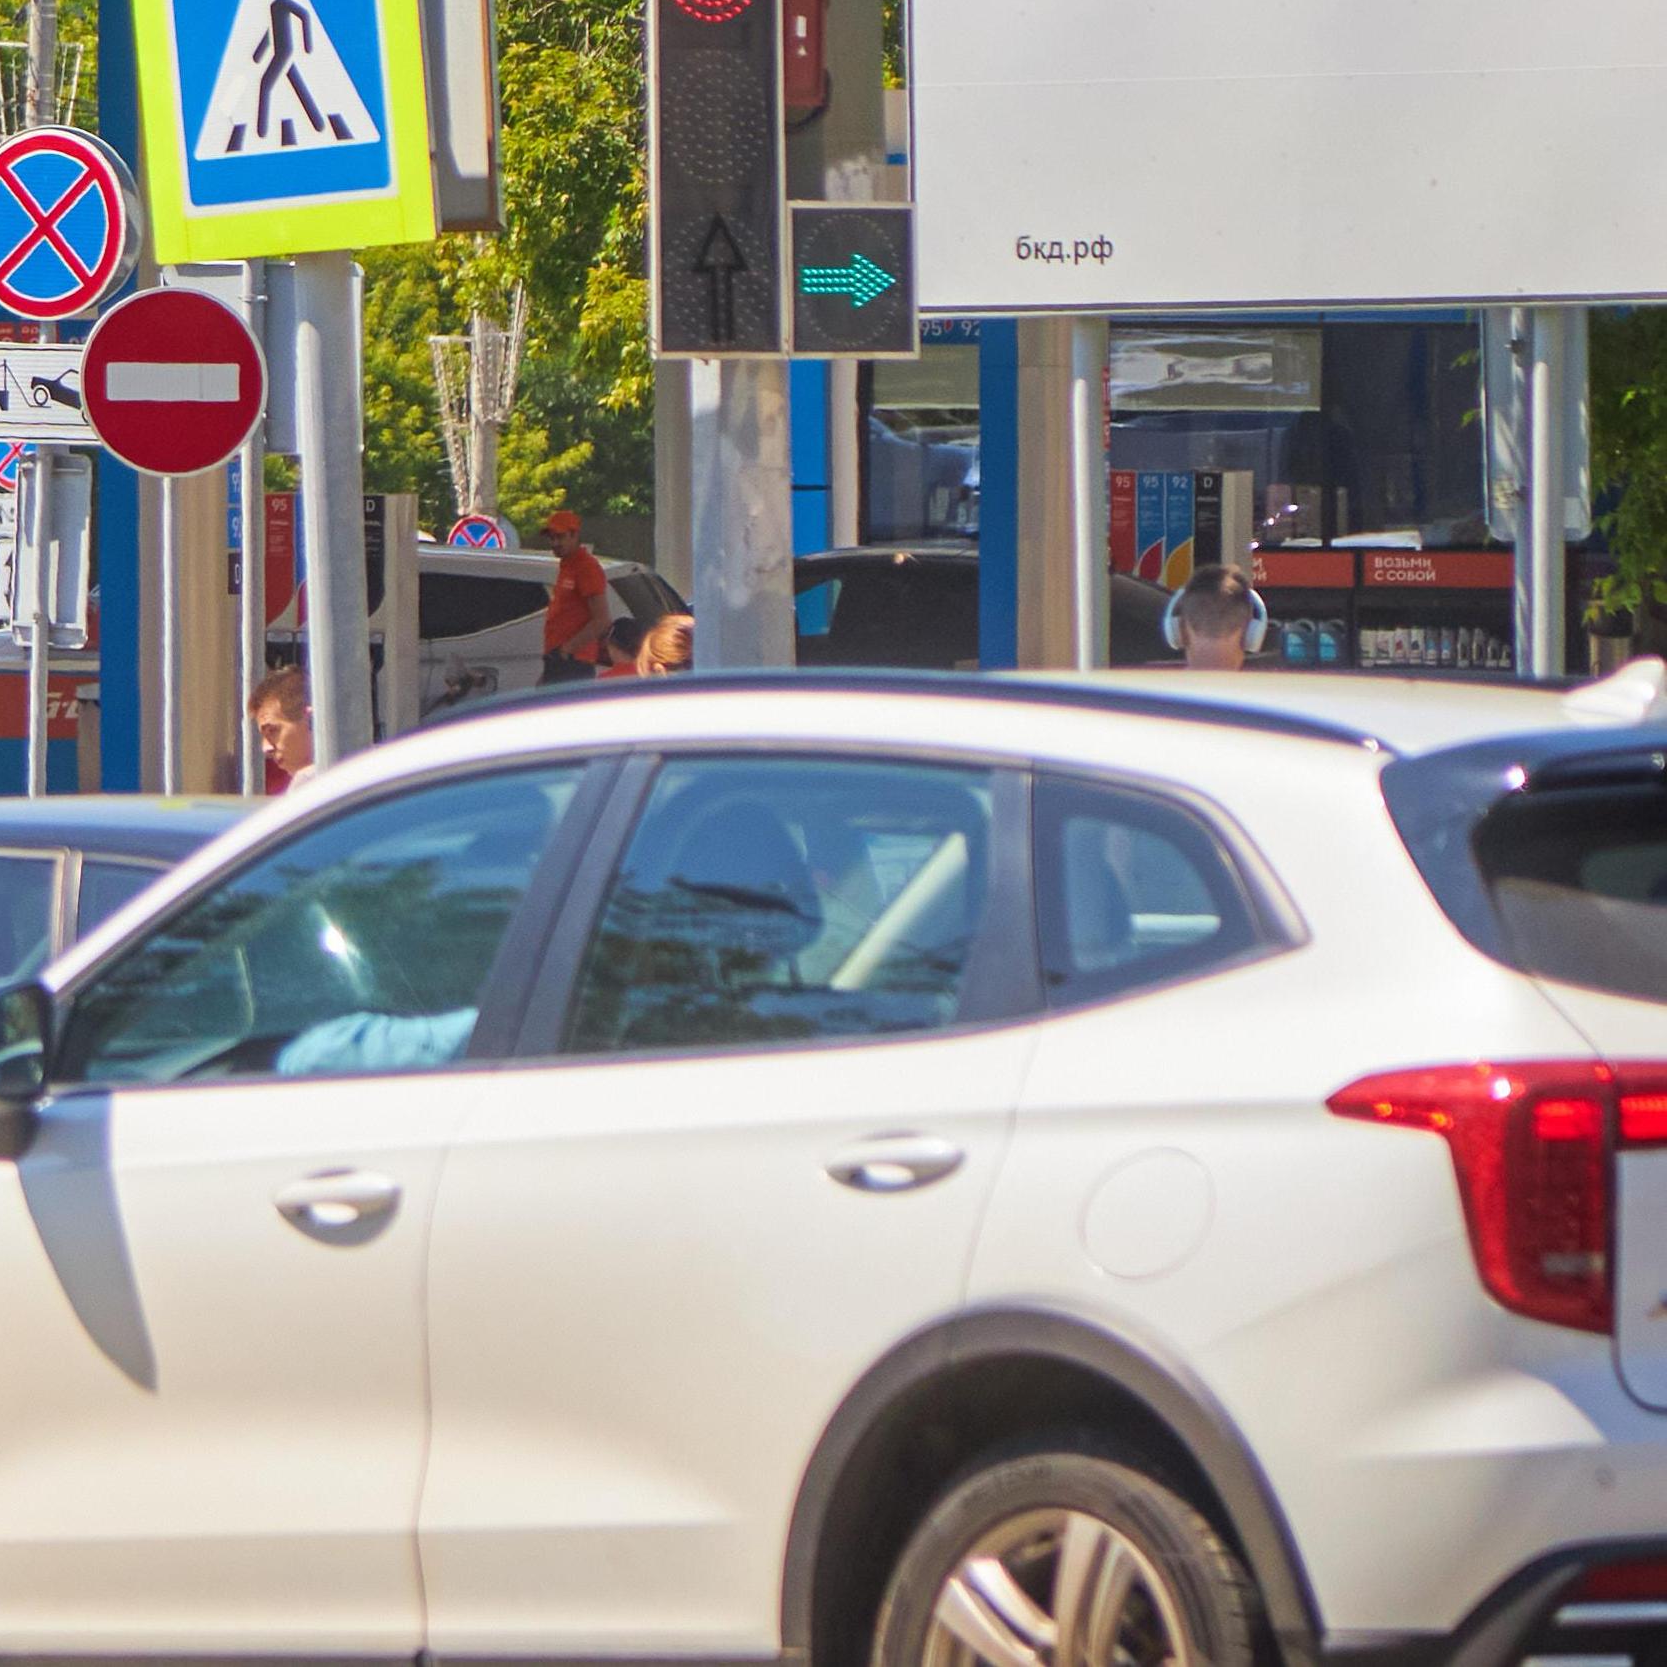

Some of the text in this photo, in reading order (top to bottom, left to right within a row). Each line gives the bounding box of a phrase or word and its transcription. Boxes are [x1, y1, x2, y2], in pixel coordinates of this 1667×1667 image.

[1016, 235, 1114, 265] бкд.рф
[1115, 476, 1131, 488] 95
[1143, 476, 1159, 488] 95
[1172, 476, 1188, 488] 92
[1203, 477, 1213, 489] D
[271, 498, 287, 512] 95
[1374, 557, 1433, 569] ВОЗЬМИ
[1374, 568, 1436, 582] С СОБОЙ
